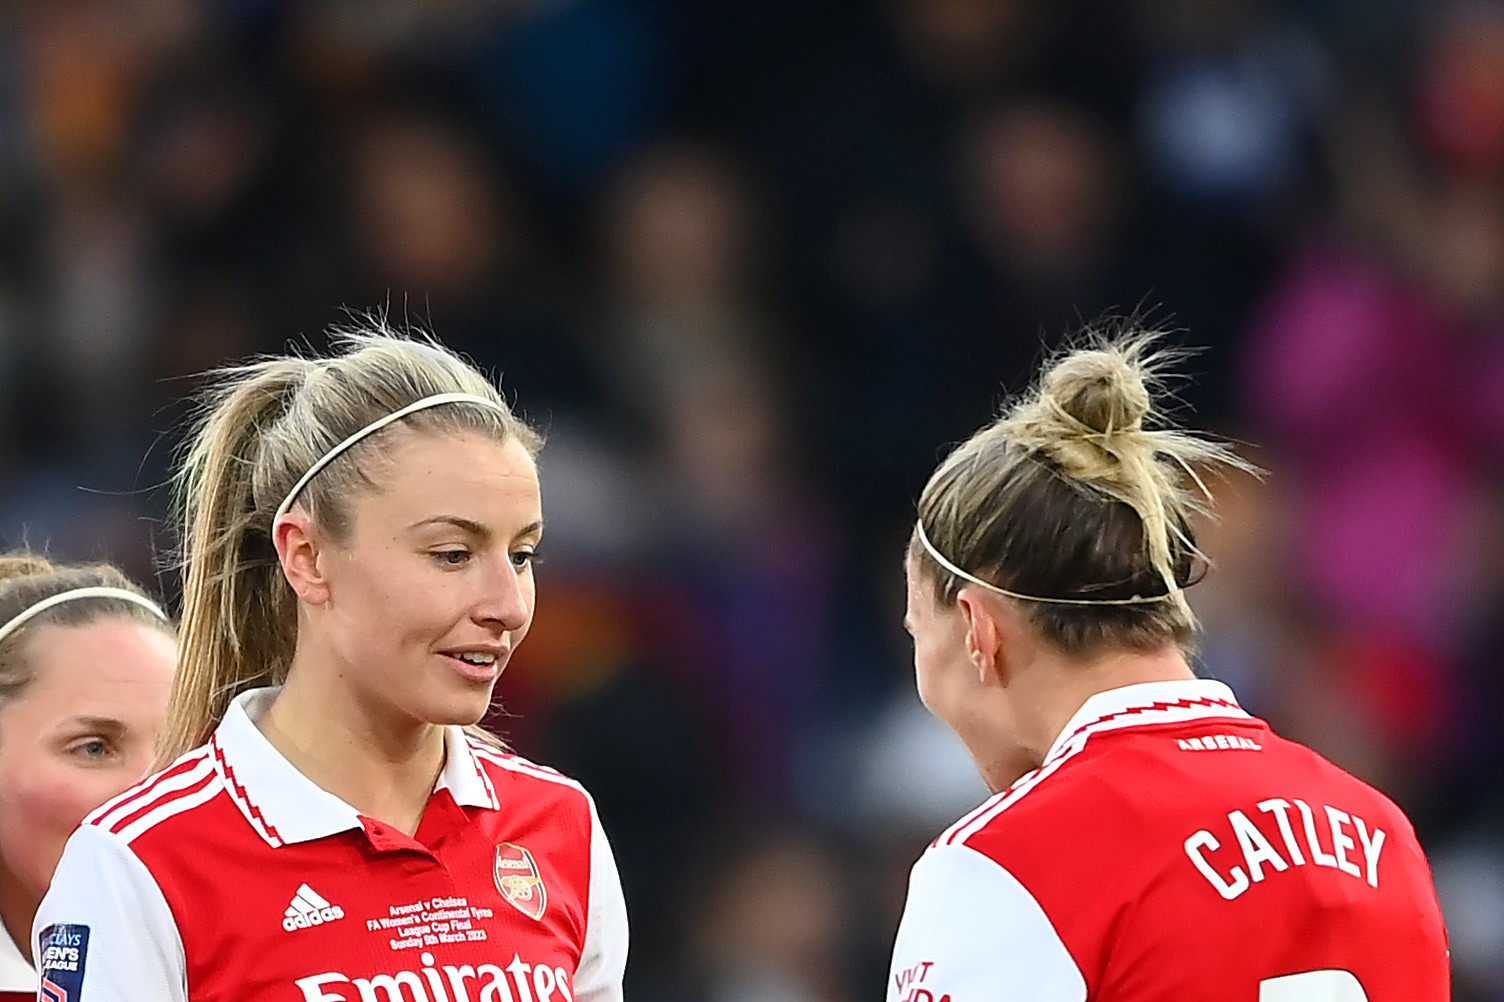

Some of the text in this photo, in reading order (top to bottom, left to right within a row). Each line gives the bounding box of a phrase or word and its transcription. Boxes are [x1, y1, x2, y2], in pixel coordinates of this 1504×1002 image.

[1173, 734, 1262, 750] ARSENAL
[1184, 798, 1386, 900] CATLEY
[497, 855, 530, 869] Arsenal
[389, 896, 467, 916] Arsenal v Chelsea
[282, 905, 345, 932] adidas
[366, 907, 493, 932] FA Women's Continental Tyres
[398, 919, 472, 937] League Cup Final
[389, 937, 423, 950] Sunday
[439, 931, 466, 943] March
[466, 929, 487, 941] 2023
